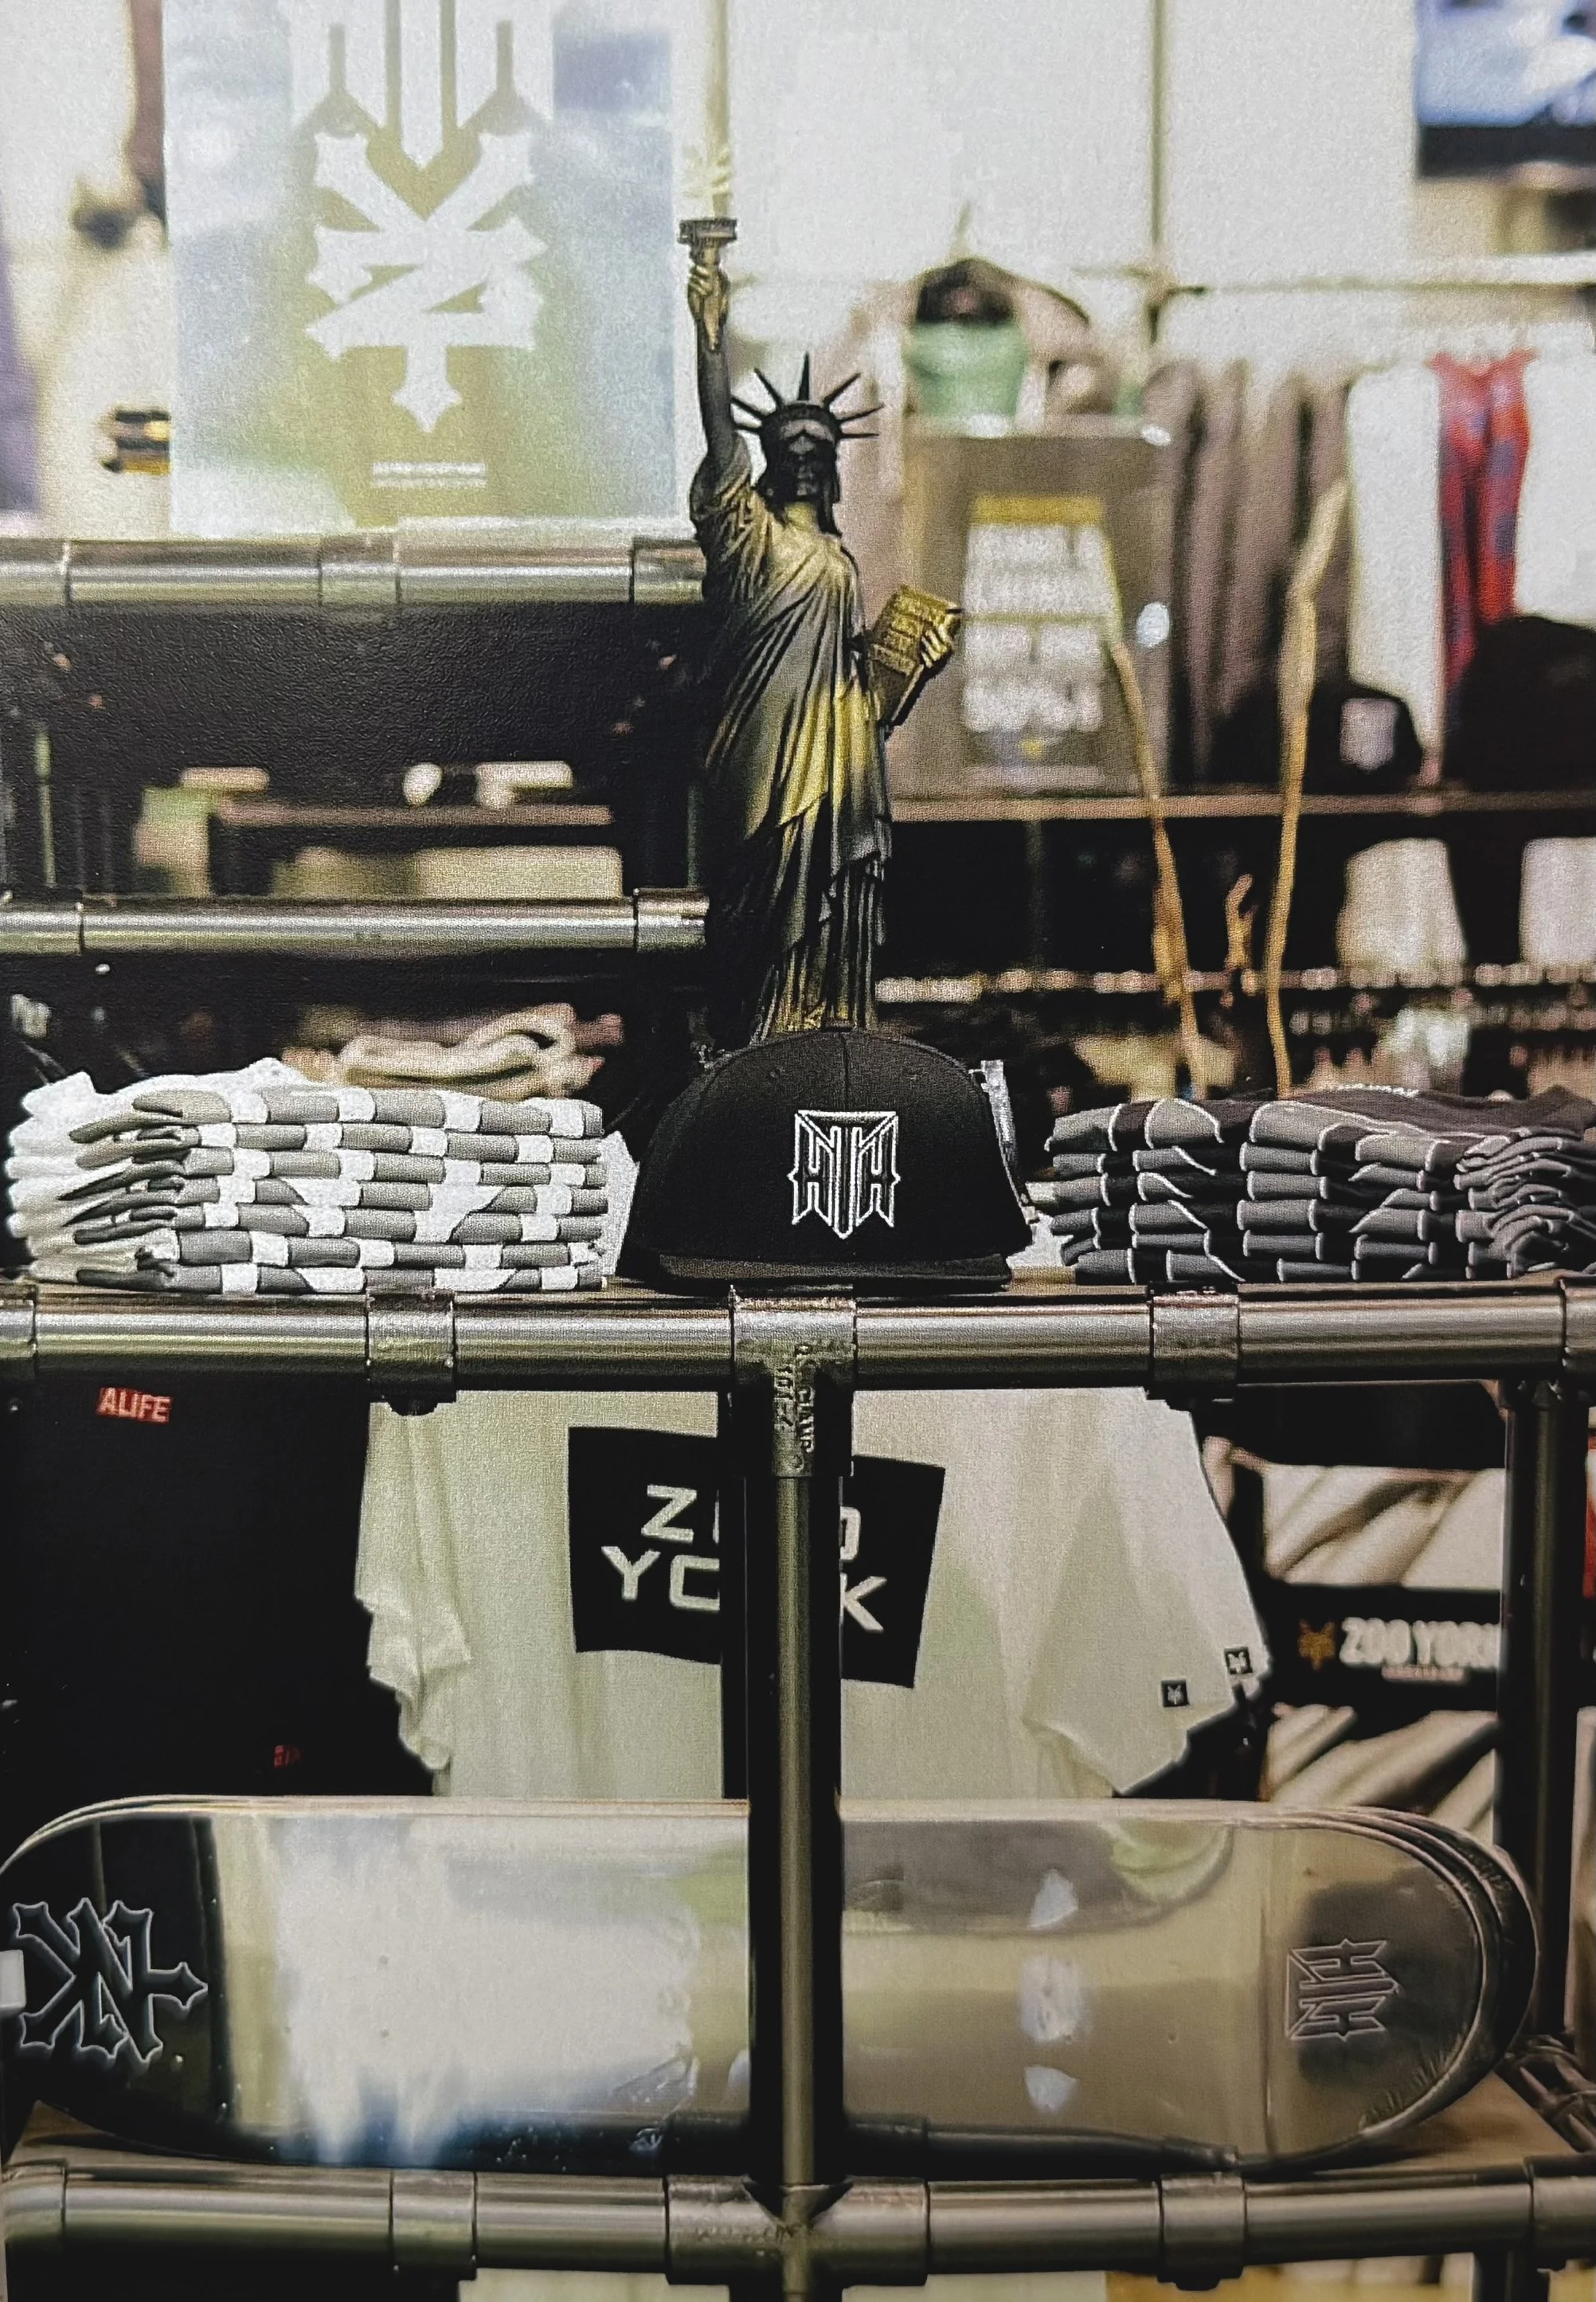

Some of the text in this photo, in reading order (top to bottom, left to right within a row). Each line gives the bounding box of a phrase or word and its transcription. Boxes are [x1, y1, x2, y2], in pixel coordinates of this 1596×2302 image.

[97, 1388, 170, 1423] ALIFE
[600, 1545, 887, 1634] YOK
[1340, 1617, 1410, 1666] ZOO
